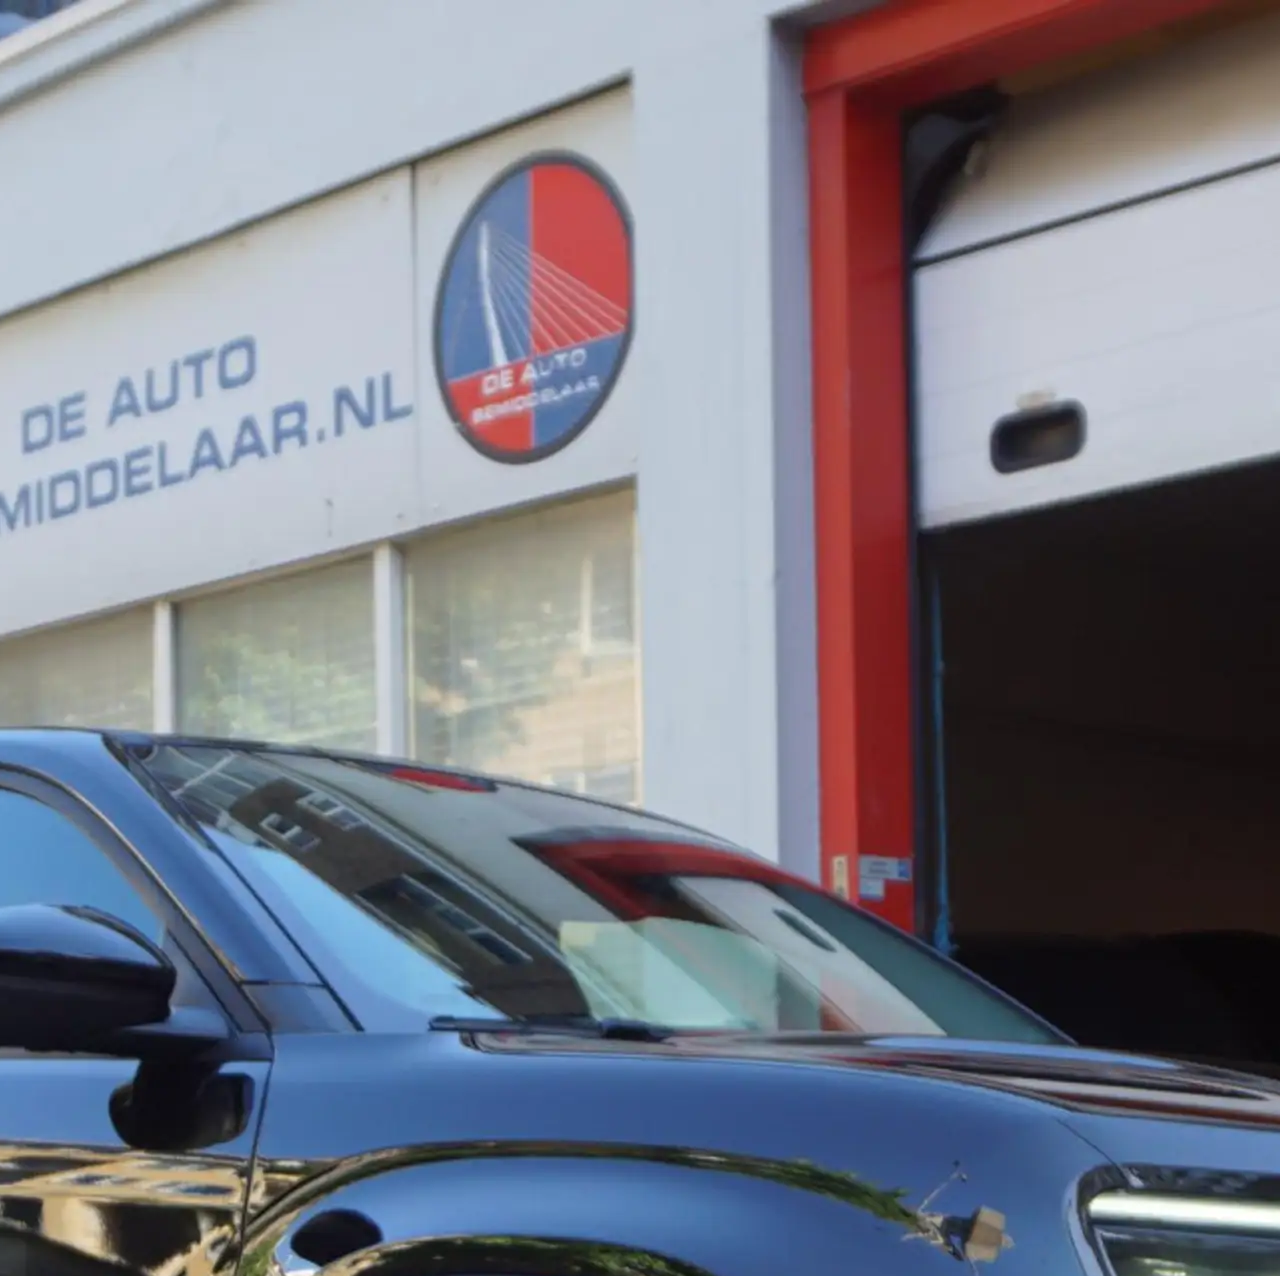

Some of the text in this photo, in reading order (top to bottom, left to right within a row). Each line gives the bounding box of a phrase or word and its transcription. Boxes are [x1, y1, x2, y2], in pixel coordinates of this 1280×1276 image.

[22, 335, 257, 455] DE AUTO
[481, 348, 587, 396] DE AUTO
